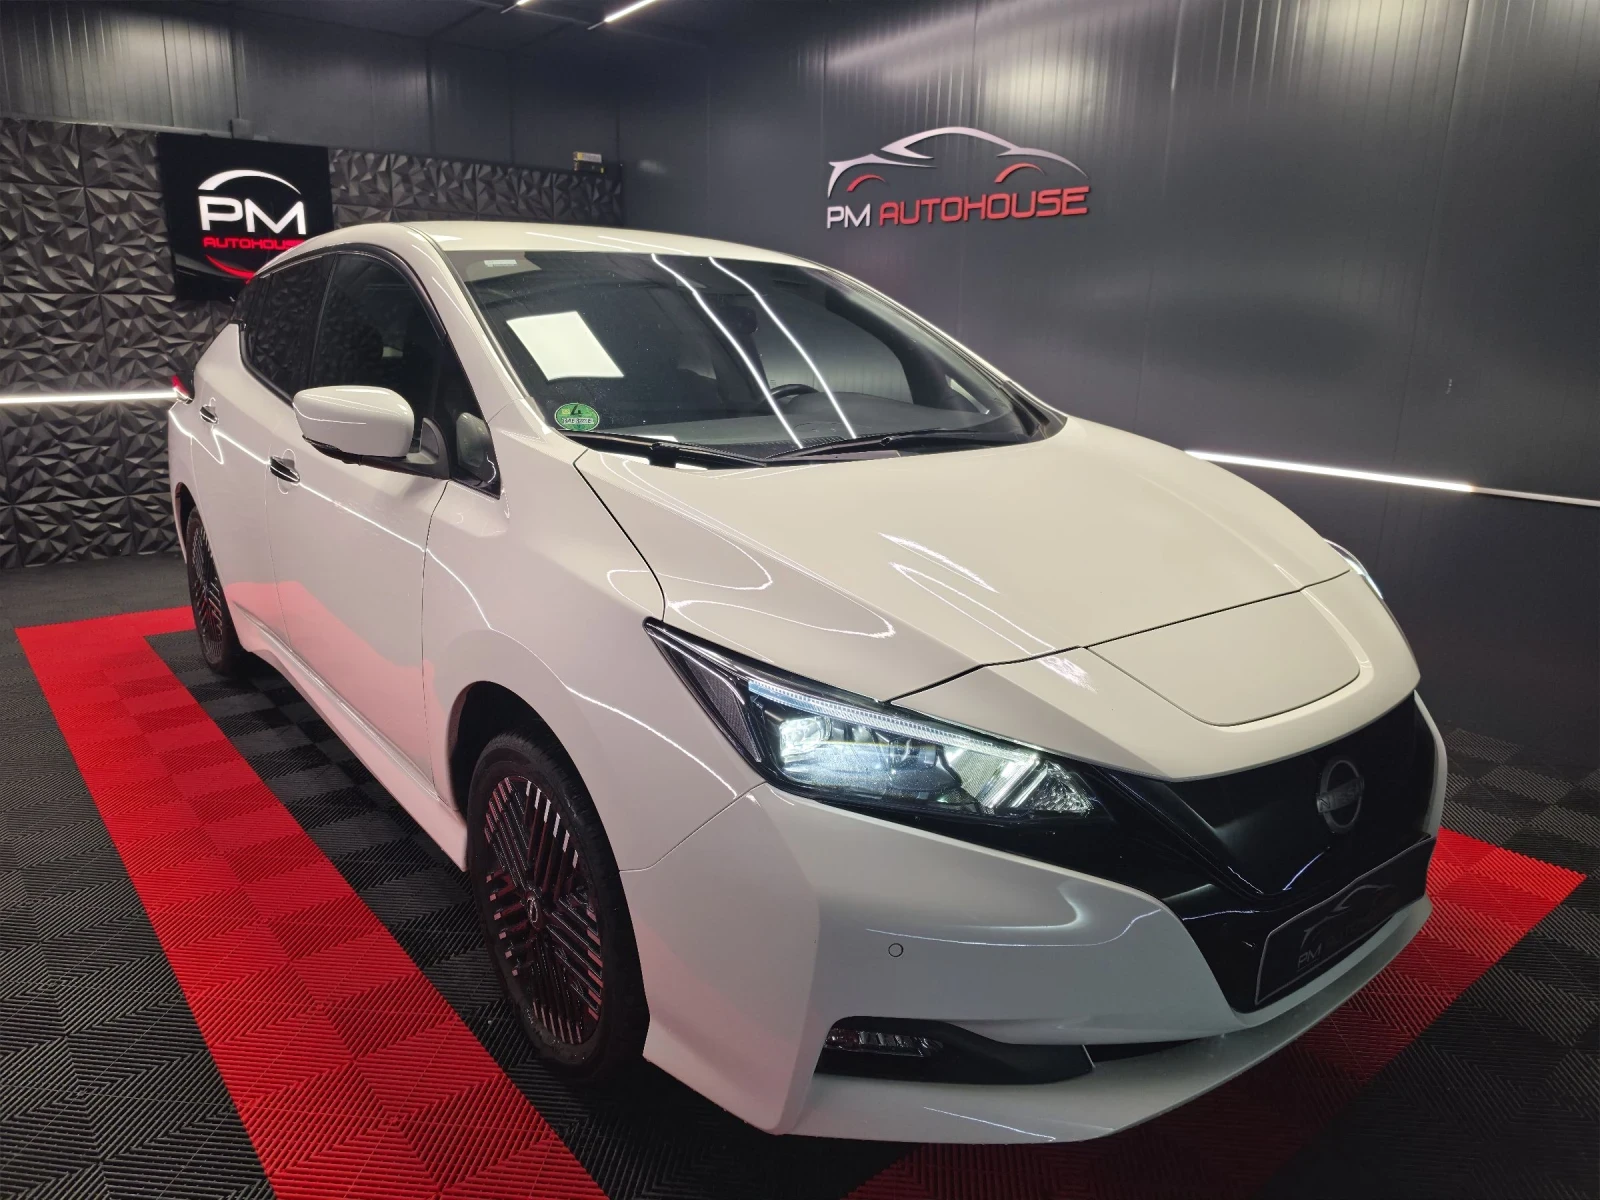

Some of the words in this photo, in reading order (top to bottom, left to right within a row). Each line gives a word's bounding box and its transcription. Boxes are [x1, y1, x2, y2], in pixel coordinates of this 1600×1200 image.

[198, 195, 307, 235] PM
[827, 203, 871, 228] PM
[879, 186, 1090, 226] AUTOHOUSE
[203, 237, 304, 250] AUTOHOUS
